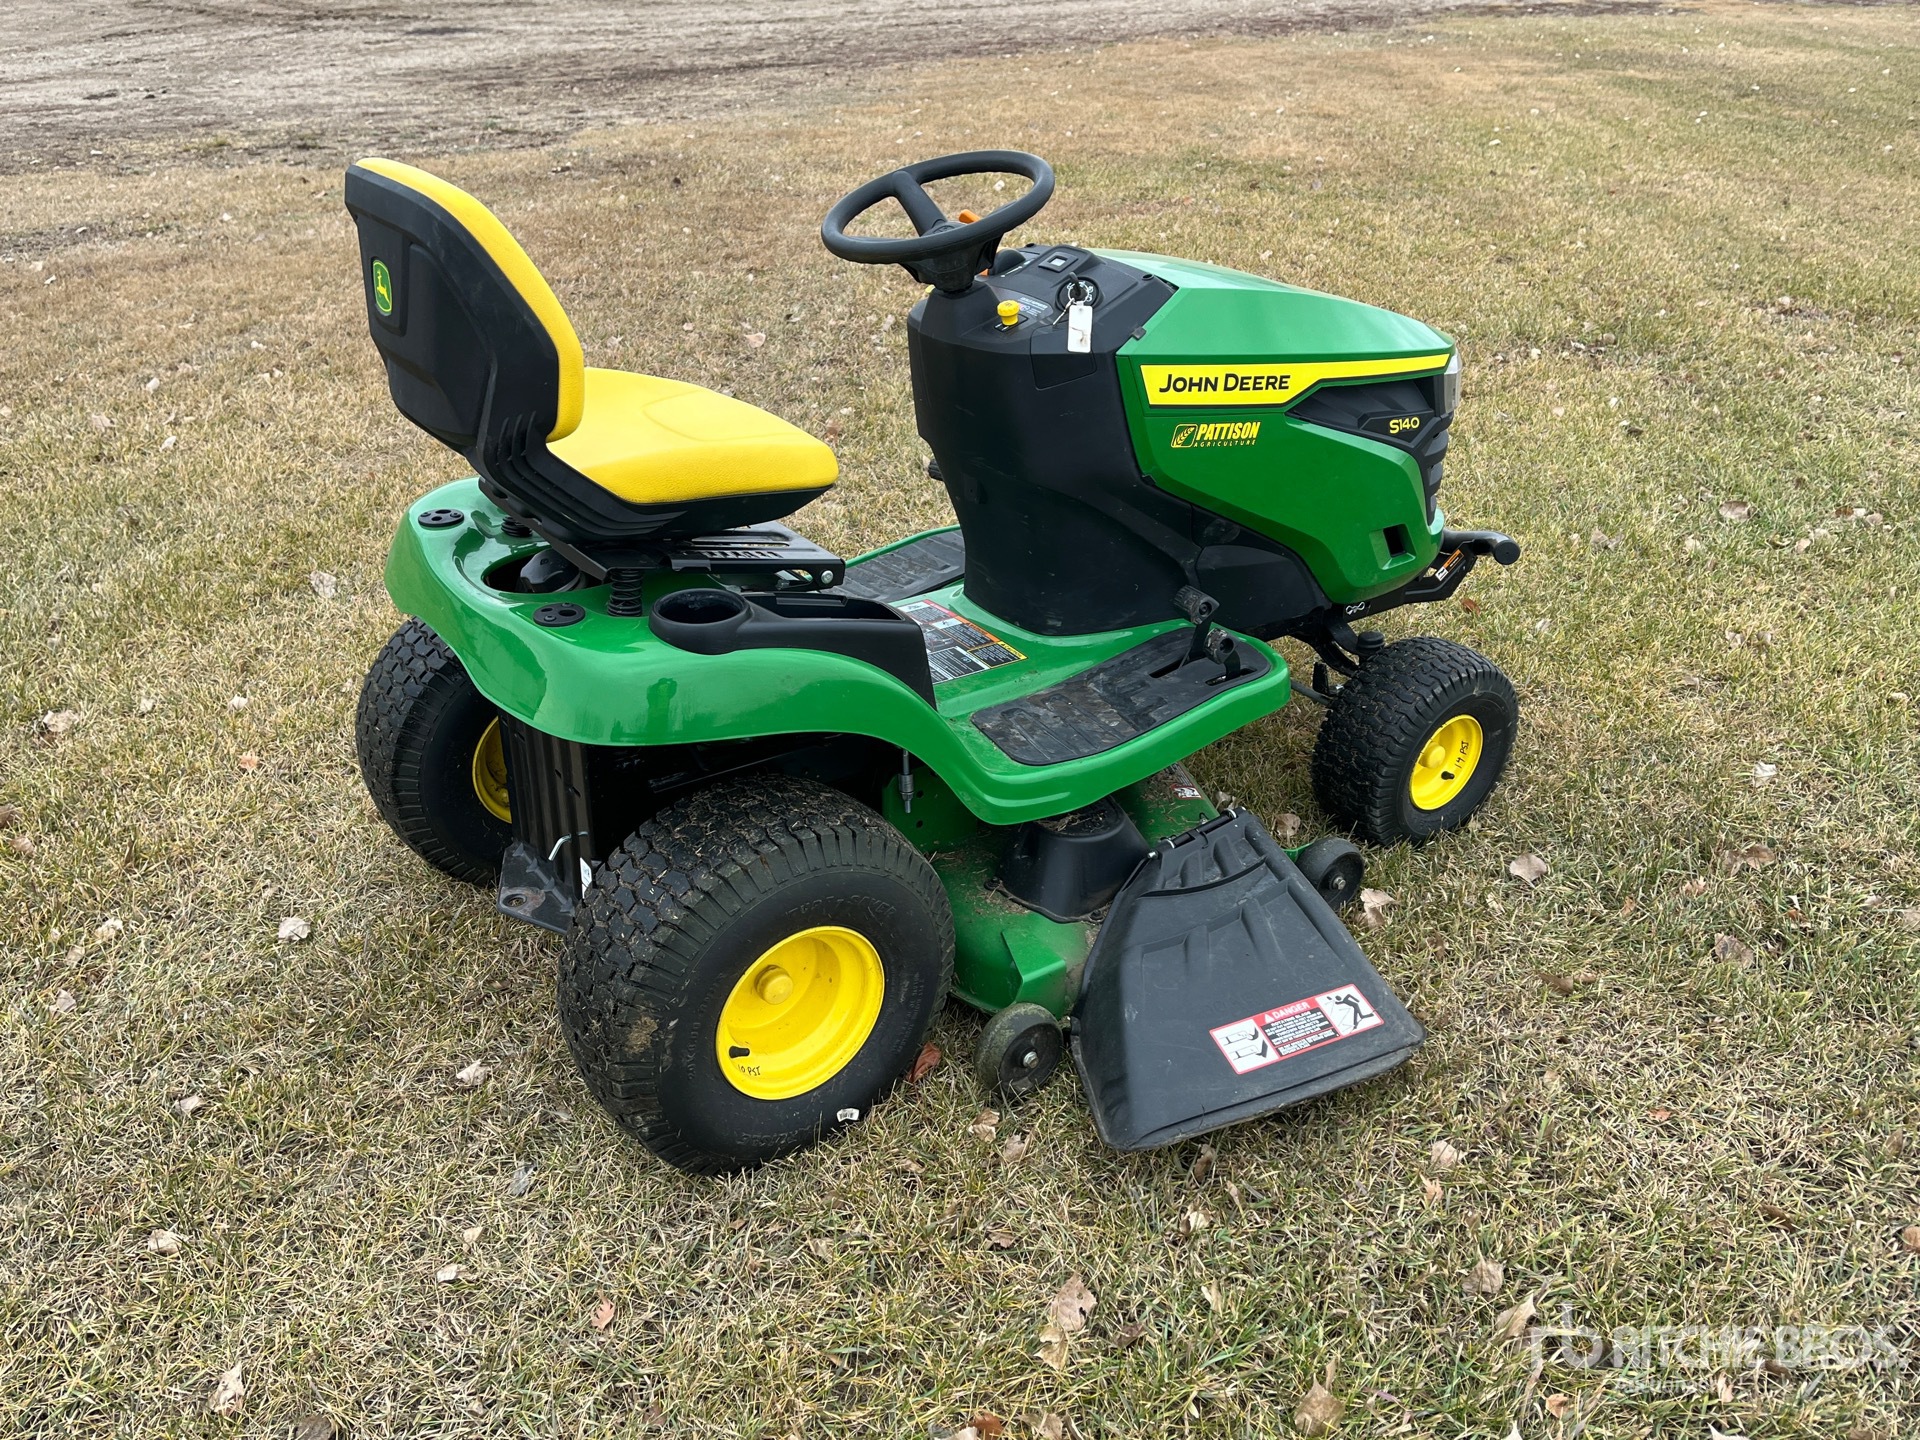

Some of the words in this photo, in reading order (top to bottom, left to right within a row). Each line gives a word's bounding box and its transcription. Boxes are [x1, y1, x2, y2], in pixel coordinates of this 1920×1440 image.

[1159, 374, 1219, 393] JOHN
[1223, 373, 1291, 392] DEERE
[1195, 421, 1261, 441] PATTISON
[1389, 416, 1420, 434] S140
[1194, 439, 1257, 448] AGRICULTURE
[1272, 1001, 1310, 1019] DANGER
